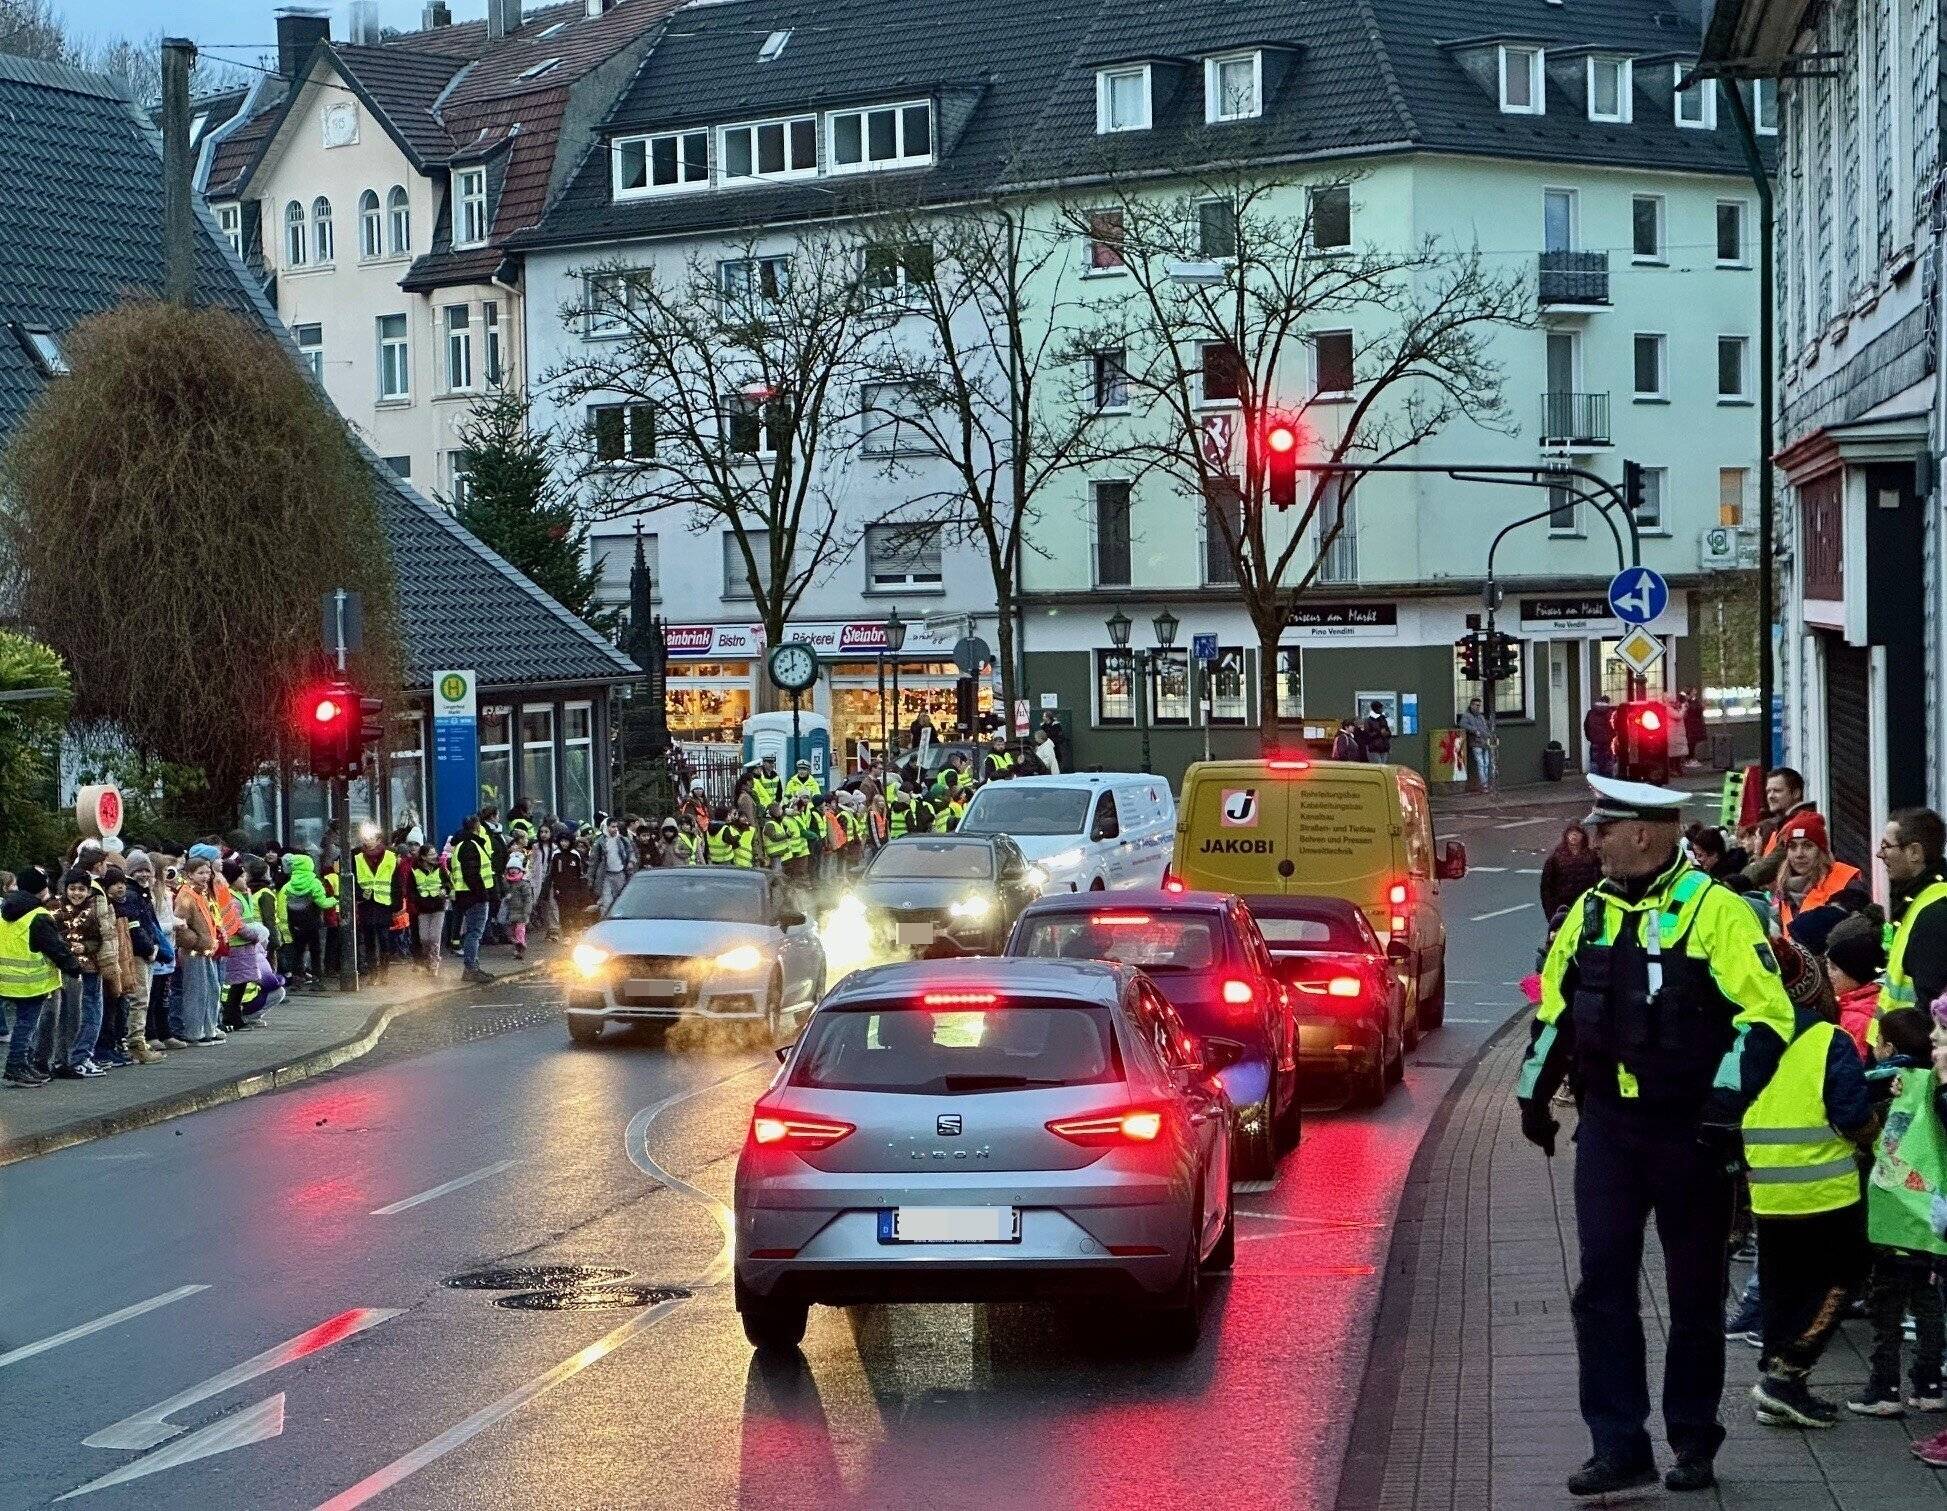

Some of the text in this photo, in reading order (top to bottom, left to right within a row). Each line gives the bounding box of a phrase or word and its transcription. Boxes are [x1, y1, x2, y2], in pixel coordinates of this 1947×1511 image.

[1327, 614, 1342, 622] am
[1348, 608, 1377, 622] Markt
[661, 630, 710, 646] einbrink
[718, 634, 746, 647] Bistro
[1200, 839, 1274, 854] JAKOBI
